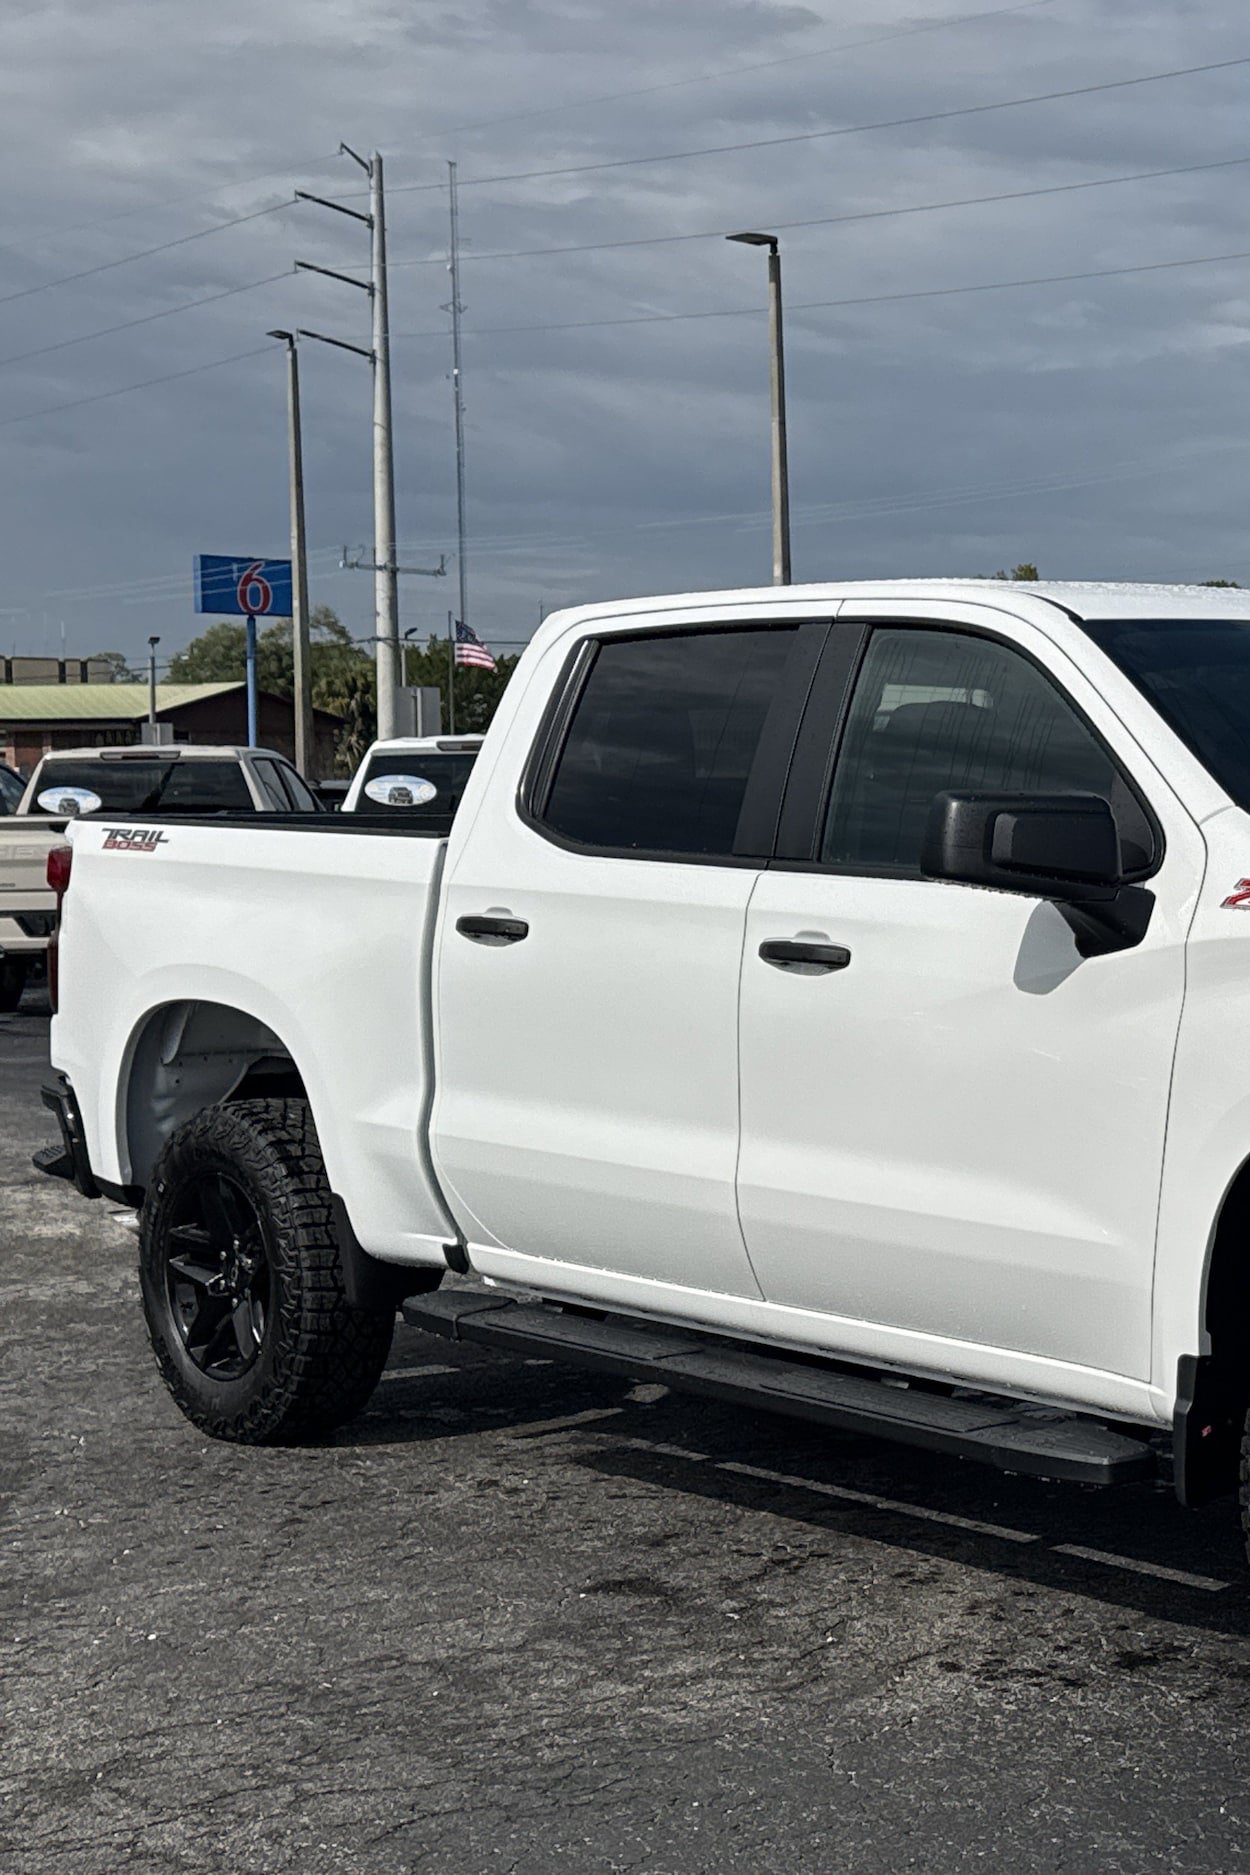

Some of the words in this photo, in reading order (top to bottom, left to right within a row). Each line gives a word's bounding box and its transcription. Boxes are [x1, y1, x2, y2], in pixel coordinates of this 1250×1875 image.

[237, 560, 273, 614] 6
[101, 828, 170, 844] TRAIL
[101, 840, 159, 853] BOSS
